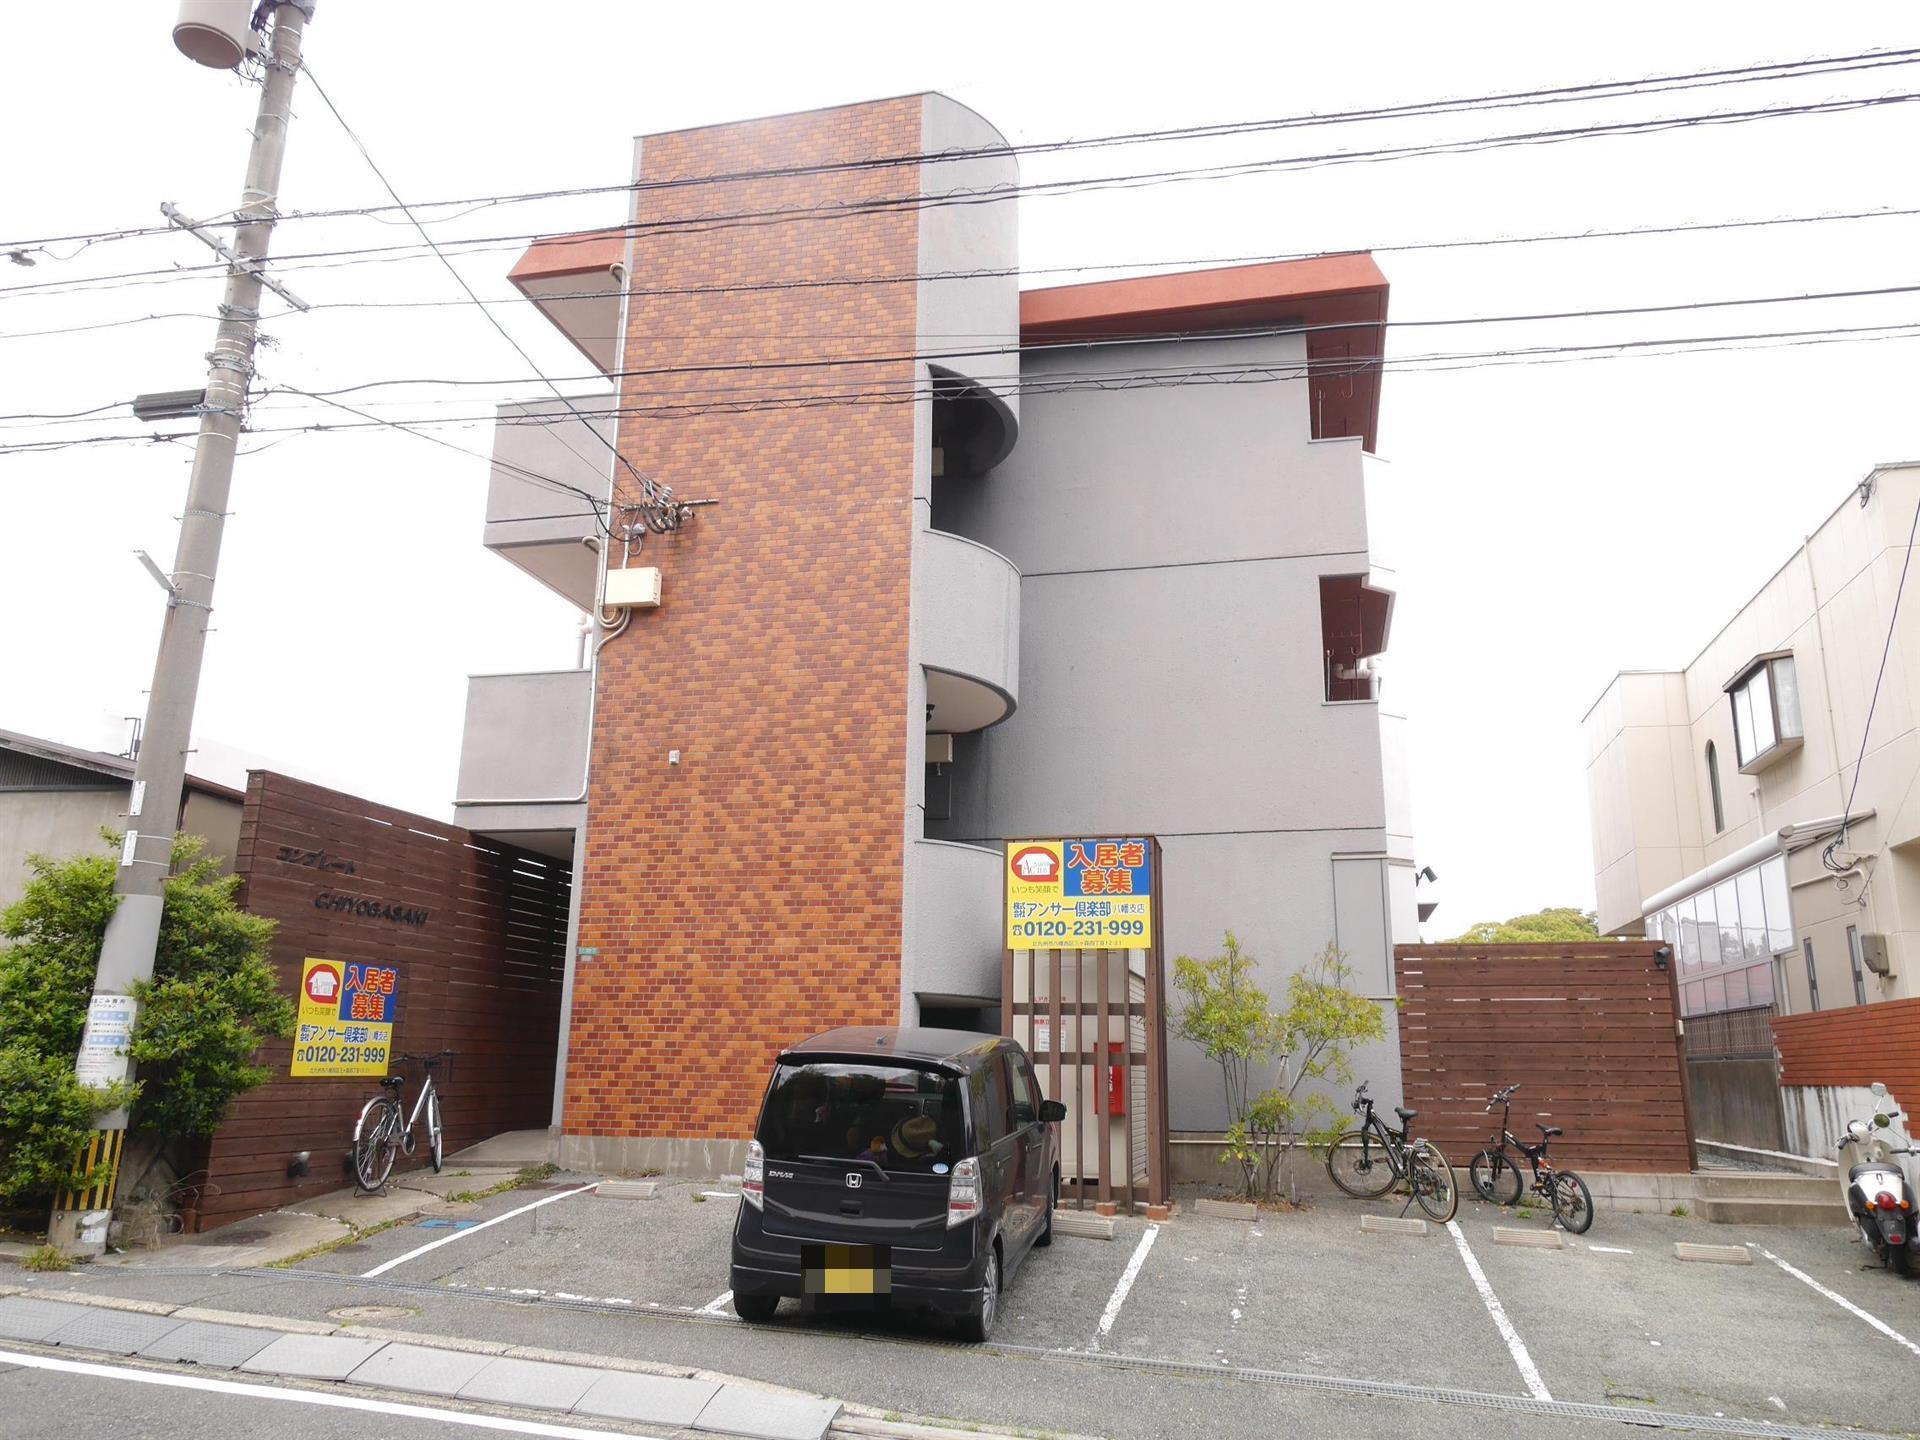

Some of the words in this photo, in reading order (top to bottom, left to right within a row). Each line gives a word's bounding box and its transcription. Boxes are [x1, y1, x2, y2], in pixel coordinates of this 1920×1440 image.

[1068, 843, 1145, 868] 入居者
[1011, 885, 1059, 894] いつも笑顔で
[1081, 869, 1132, 894] 募集
[314, 891, 429, 928] CHIYOGASAKI
[1024, 920, 1144, 936] 0120-231-999
[345, 966, 396, 994] 入居者
[351, 993, 385, 1020] 募集
[306, 1046, 385, 1063] 0120-231-999
